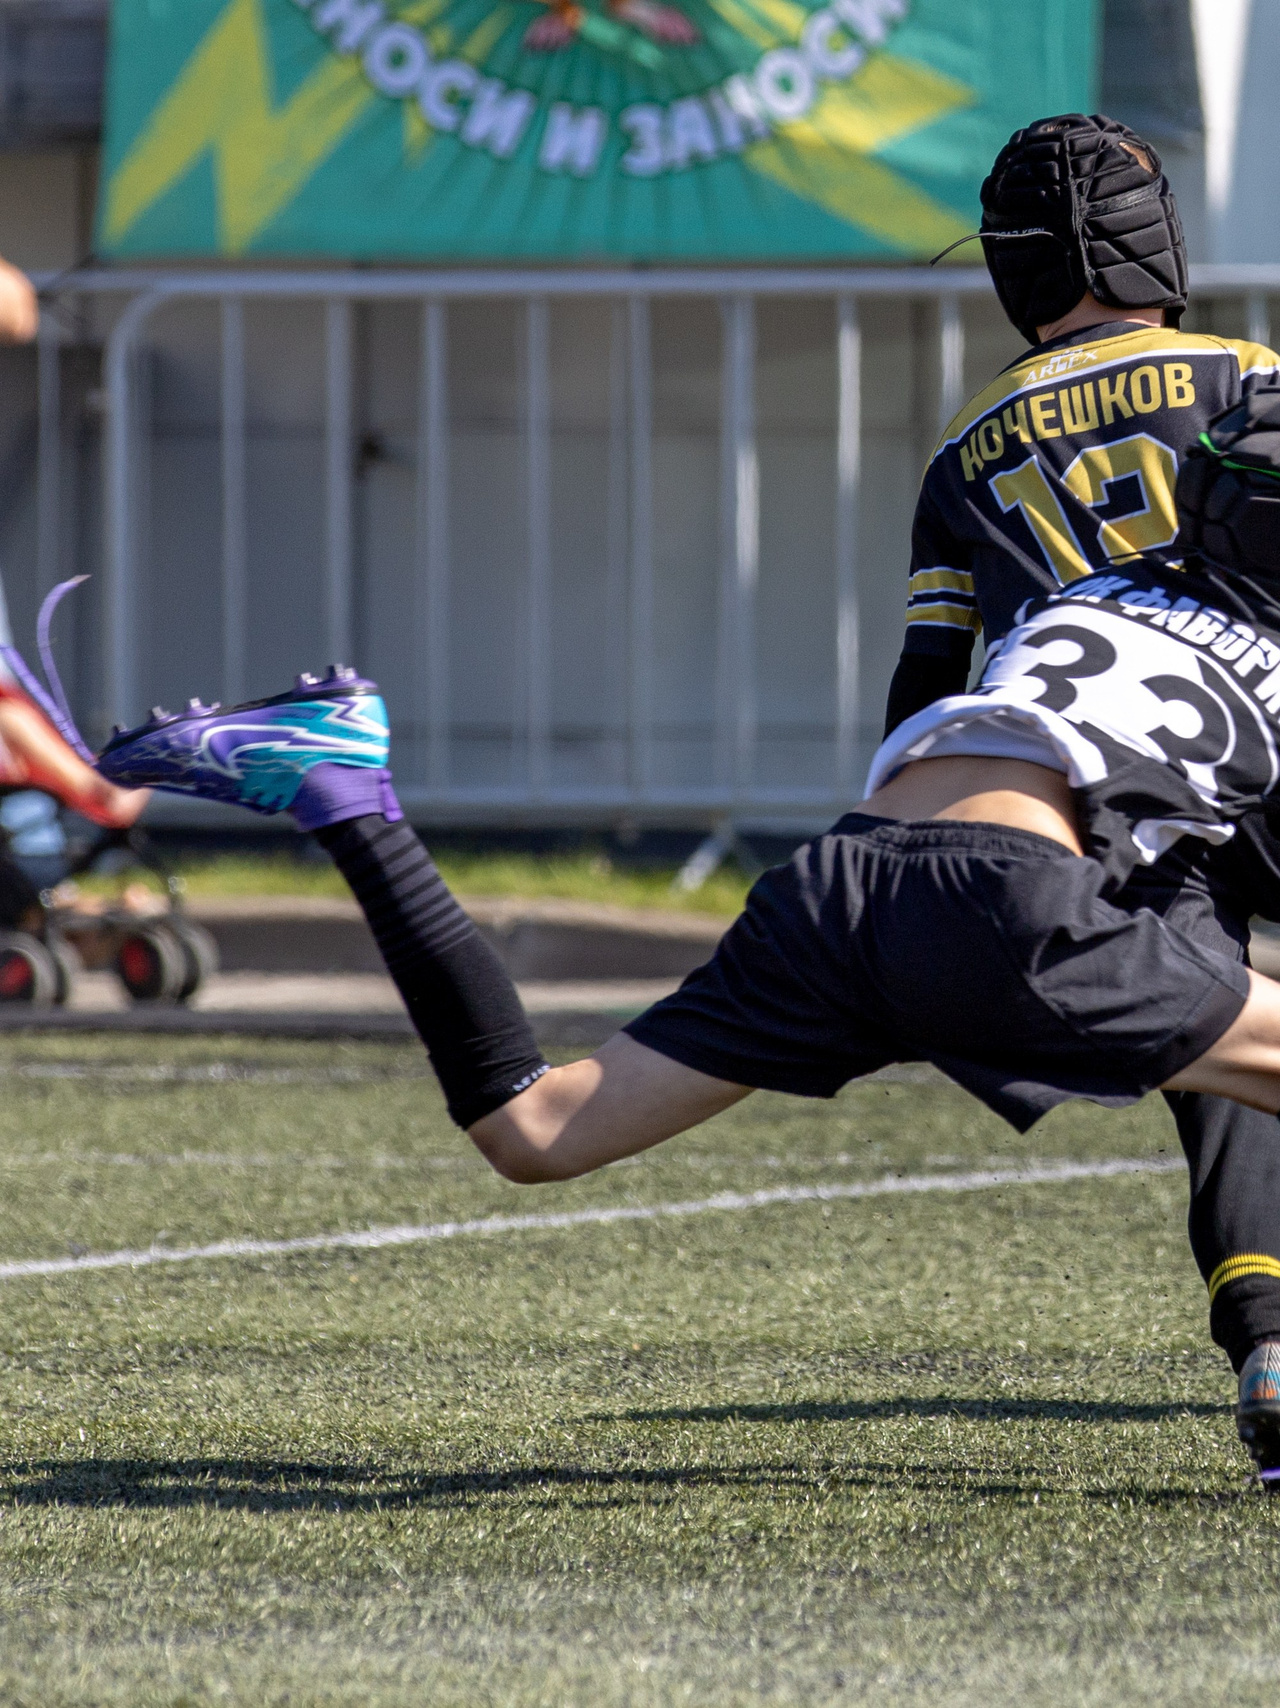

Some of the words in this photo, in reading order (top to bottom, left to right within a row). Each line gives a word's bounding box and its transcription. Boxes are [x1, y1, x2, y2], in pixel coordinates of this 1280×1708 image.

[298, 0, 538, 158] НОСИ
[540, 101, 607, 178] И
[958, 362, 1196, 482] КОЧЕШКОВ
[1021, 624, 1230, 765] 33
